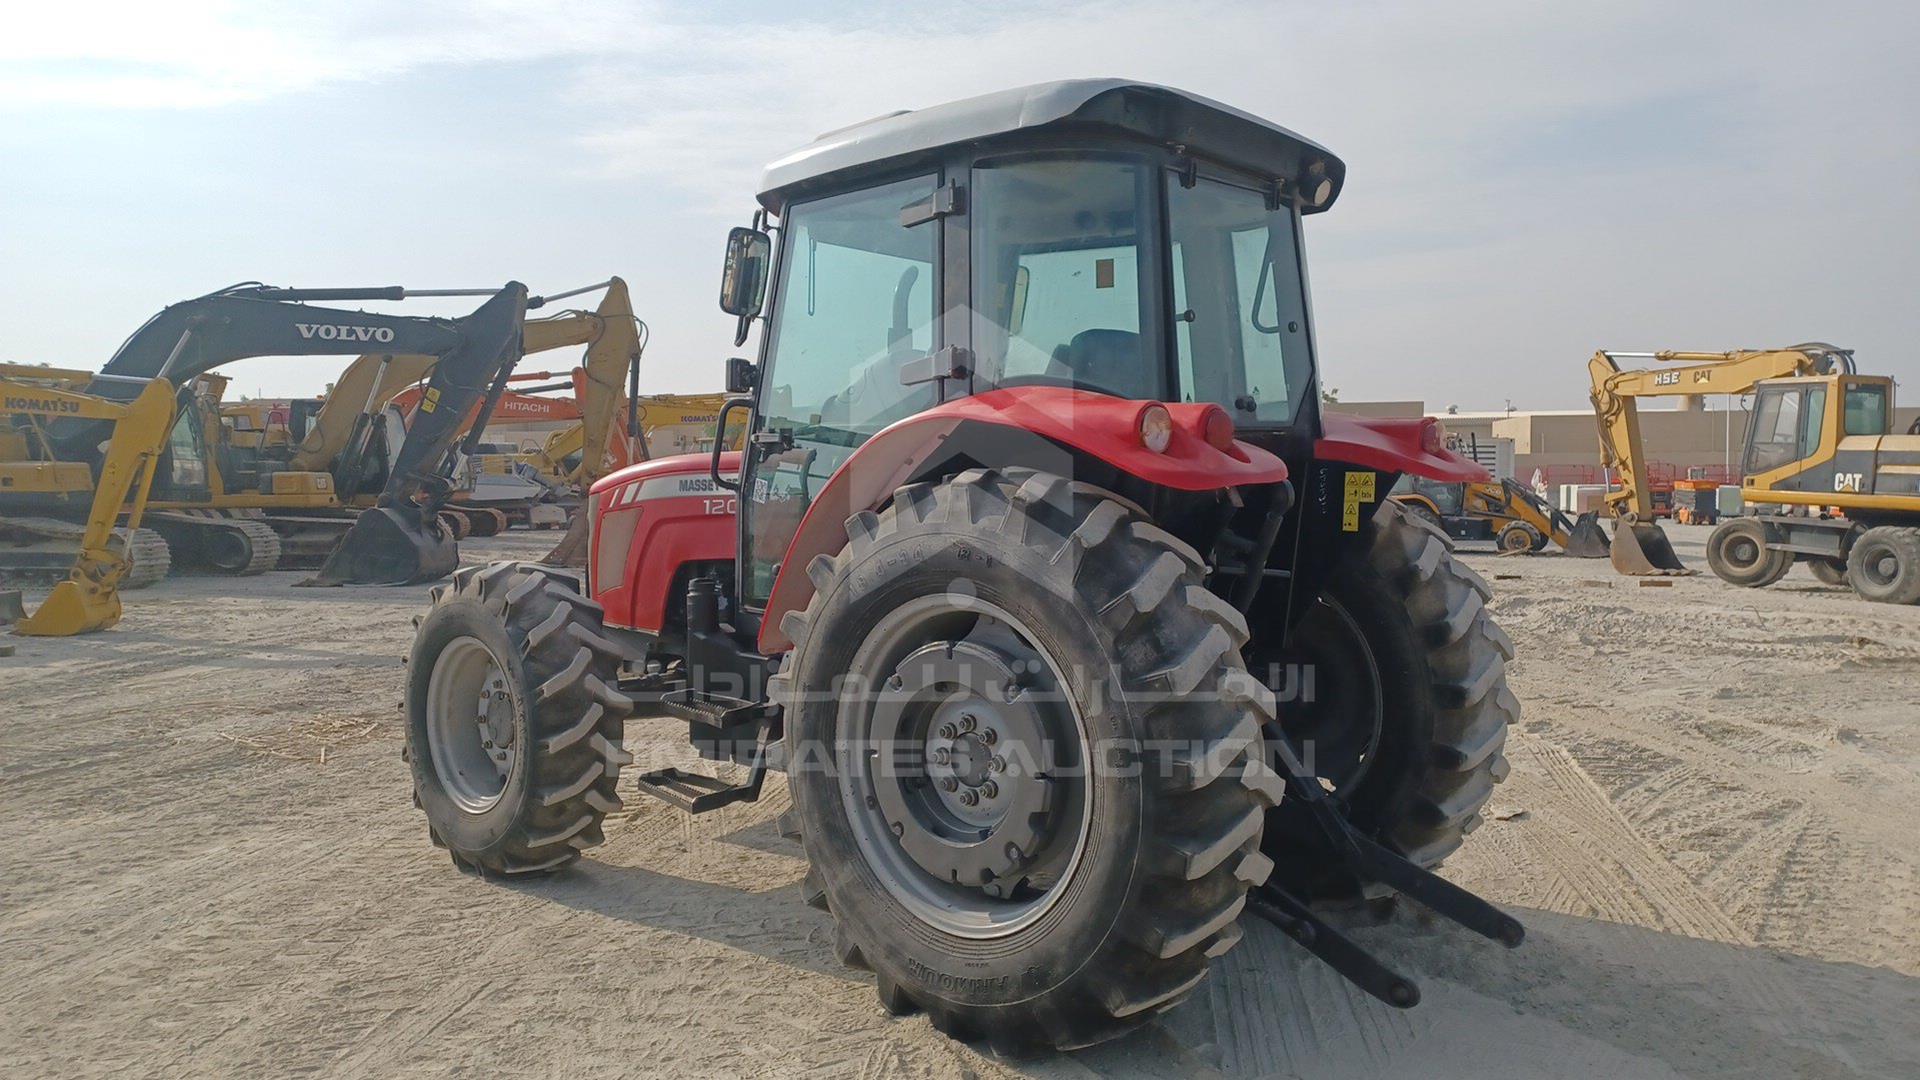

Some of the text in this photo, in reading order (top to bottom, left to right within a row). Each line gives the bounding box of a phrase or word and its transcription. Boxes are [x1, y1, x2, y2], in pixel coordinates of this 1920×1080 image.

[295, 323, 395, 342] VOLVO
[1654, 369, 1712, 386] HSE CAT
[4, 395, 80, 413] KOMATSU
[504, 401, 550, 413] HITACHI
[1834, 472, 1863, 493] CAT
